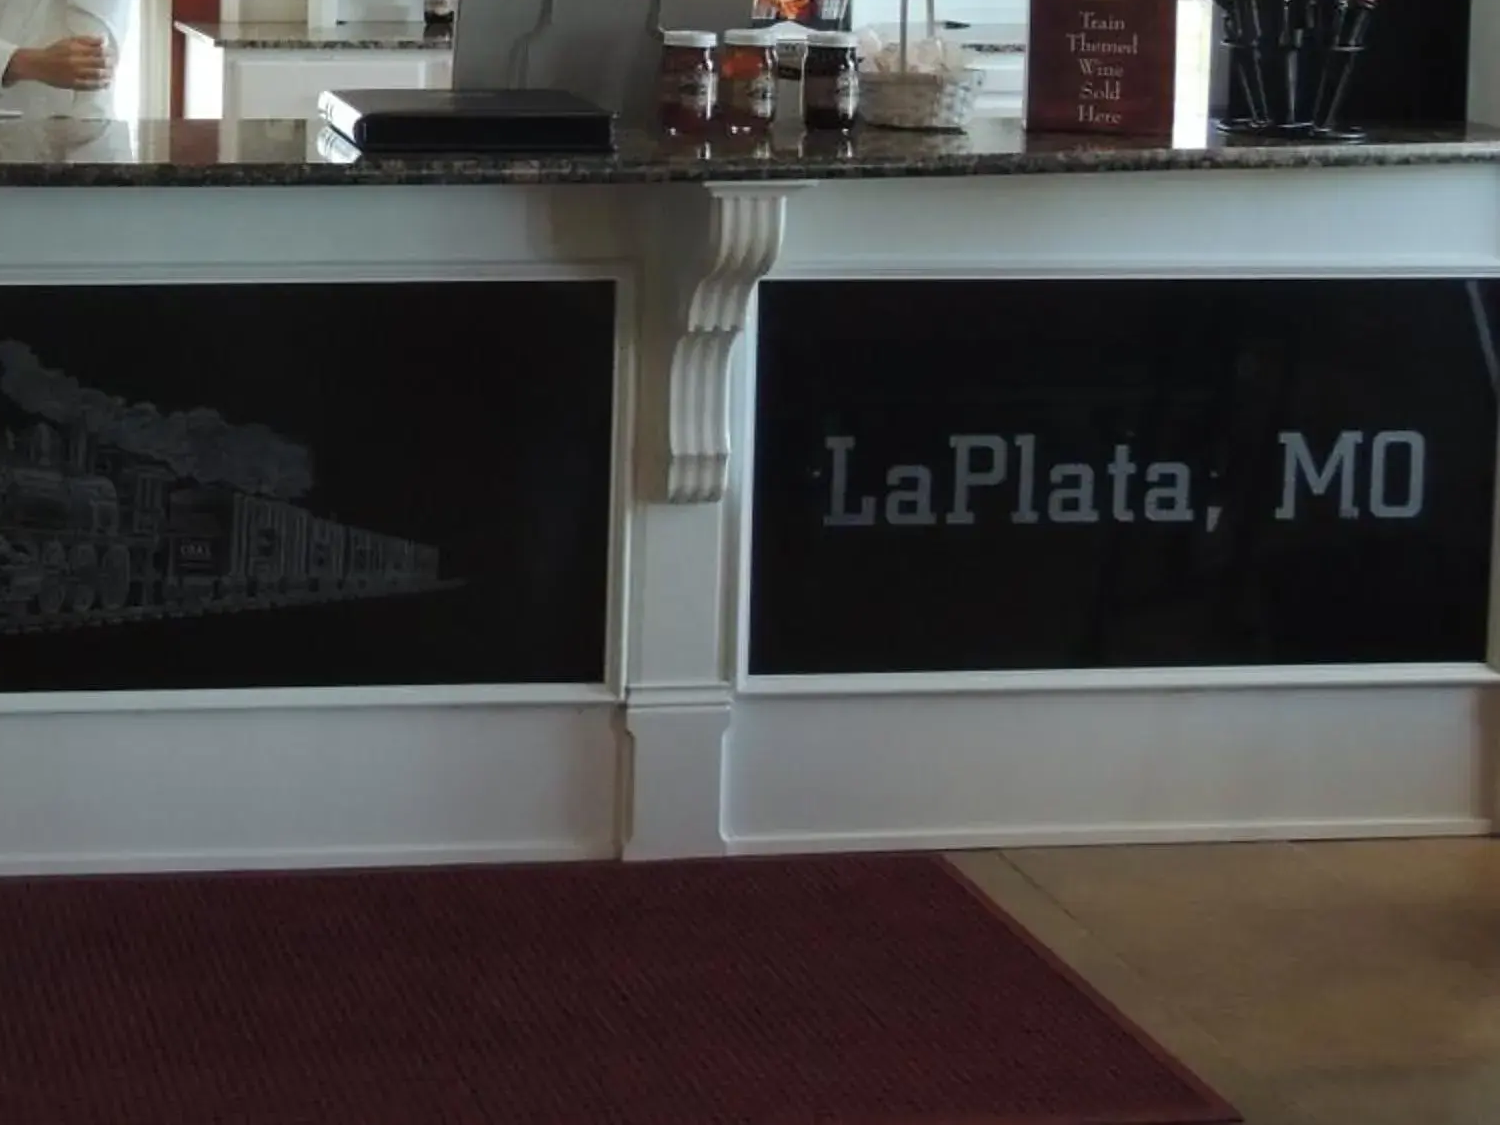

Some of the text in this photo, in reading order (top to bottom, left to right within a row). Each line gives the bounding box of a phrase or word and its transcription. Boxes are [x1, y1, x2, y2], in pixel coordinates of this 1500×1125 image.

[1079, 11, 1126, 30] Train
[1065, 33, 1139, 54] Themed
[1079, 58, 1125, 78] Wine
[1078, 80, 1121, 101] Sold
[1077, 104, 1122, 124] Here
[1274, 429, 1427, 521] MO
